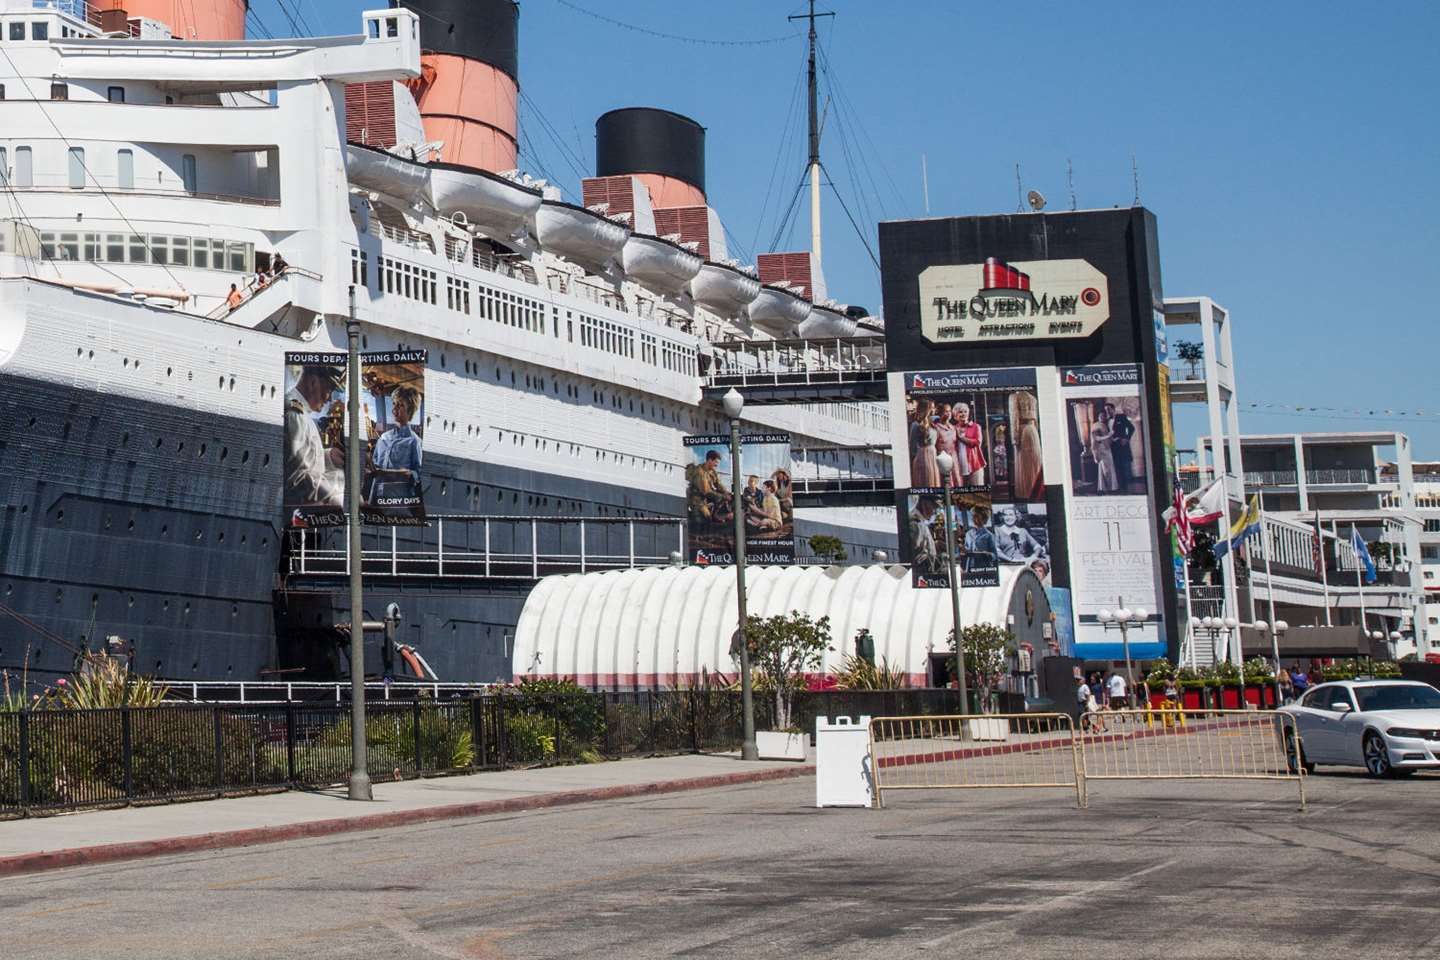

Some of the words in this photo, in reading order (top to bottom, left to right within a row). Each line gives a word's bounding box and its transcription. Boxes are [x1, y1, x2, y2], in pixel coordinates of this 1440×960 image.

[970, 296, 1026, 320] QUEEN
[1030, 291, 1079, 315] MARY
[978, 323, 1035, 335] ATTRACTIONS
[288, 354, 319, 362] TOURS
[685, 436, 709, 444] TOURS
[377, 498, 402, 506] GLORY
